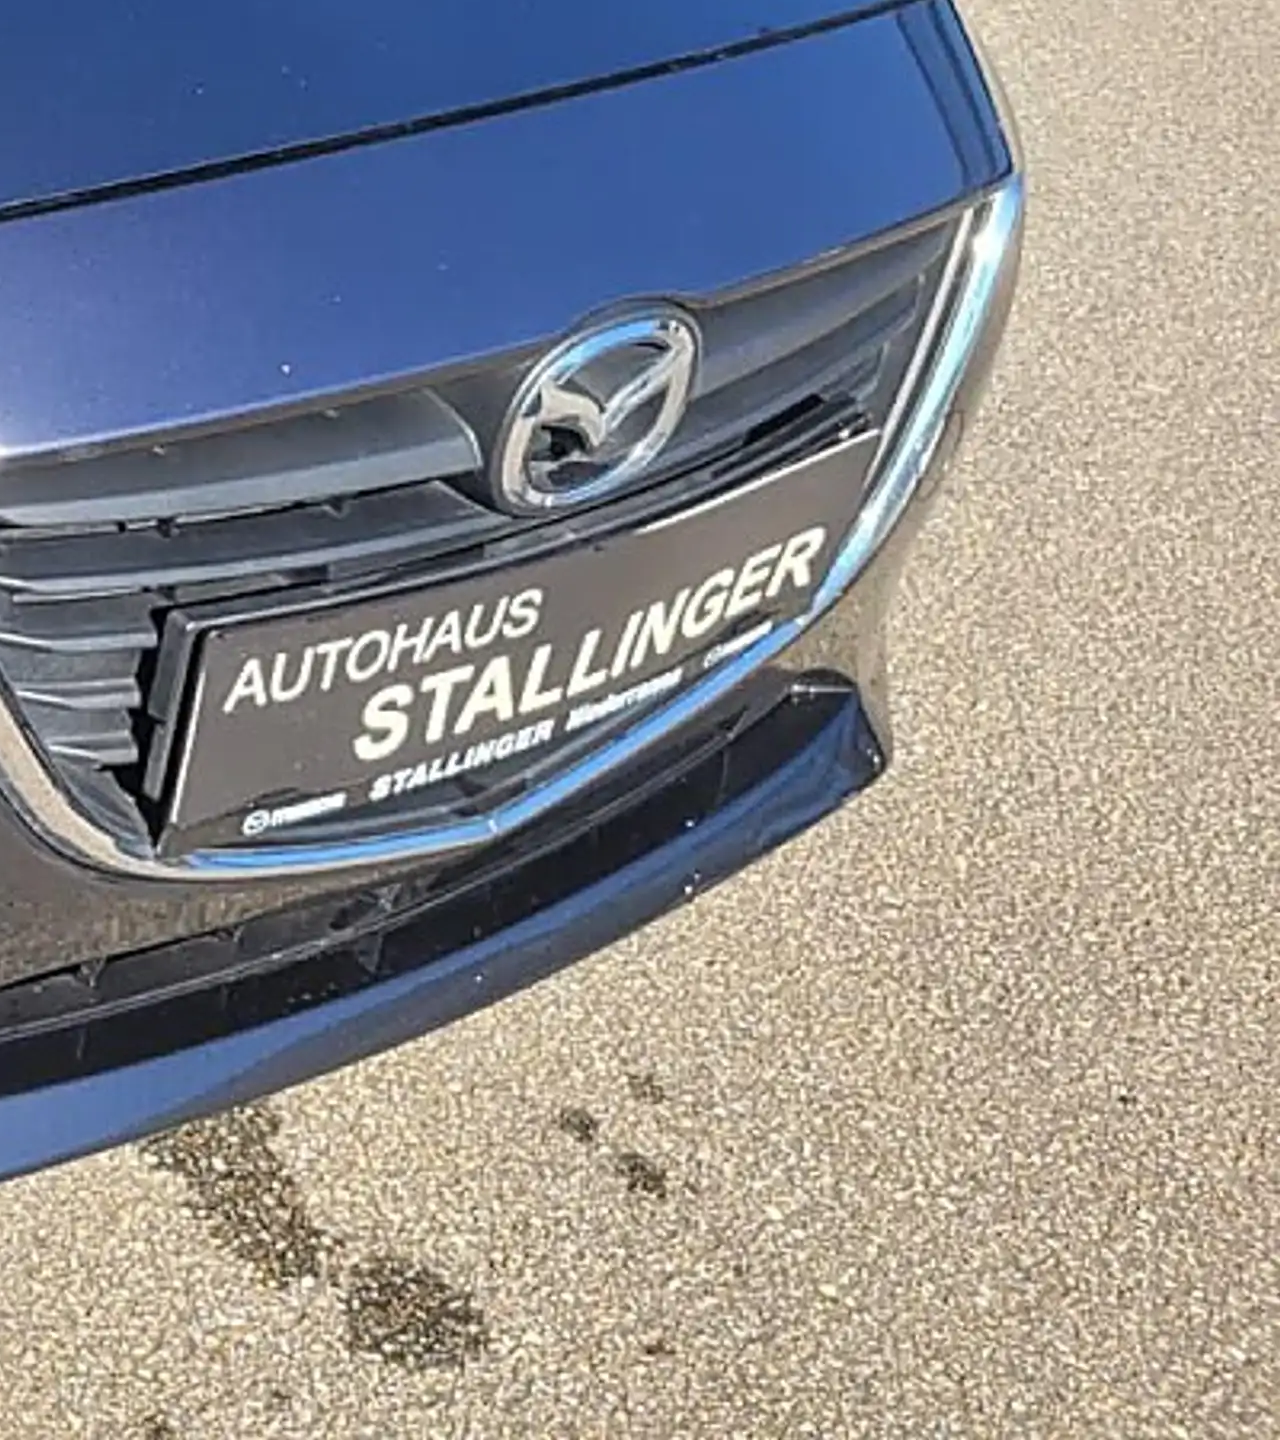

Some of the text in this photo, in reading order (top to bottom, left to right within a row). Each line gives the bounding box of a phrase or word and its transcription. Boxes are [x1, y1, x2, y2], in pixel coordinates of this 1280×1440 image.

[222, 588, 544, 714] AUTOHAUS
[352, 525, 826, 761] STALLINGER
[368, 719, 555, 802] STALLINGER
